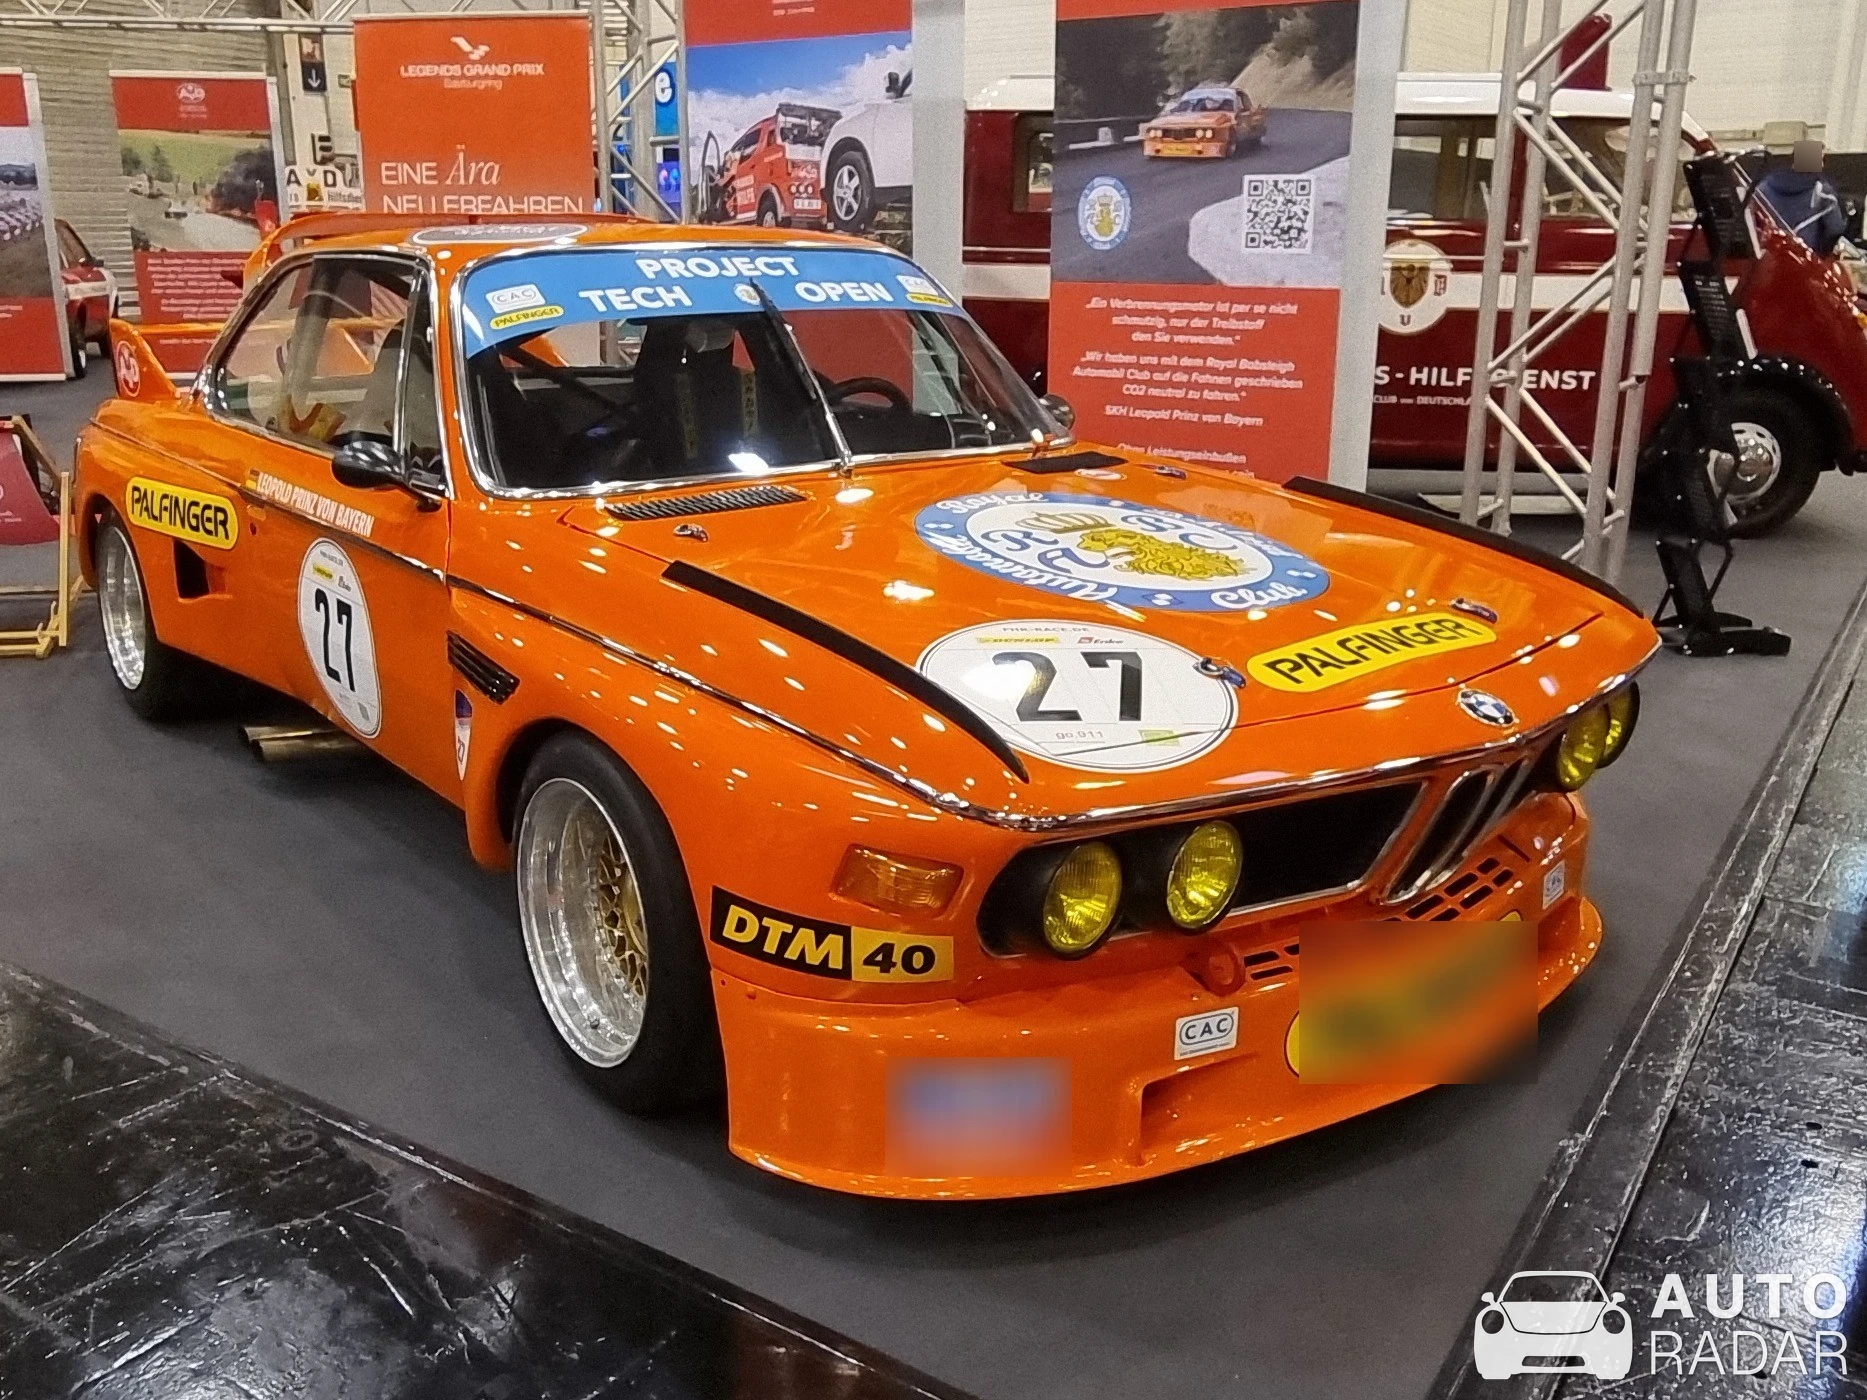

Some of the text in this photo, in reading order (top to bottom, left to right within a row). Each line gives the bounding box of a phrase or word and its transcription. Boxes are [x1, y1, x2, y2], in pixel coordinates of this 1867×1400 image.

[463, 63, 511, 76] GRAND
[512, 63, 544, 75] PRIX
[381, 144, 501, 185] EINE Ära
[383, 194, 436, 213] NEU
[443, 195, 583, 213] ERFAHREN
[635, 255, 799, 279] PROJECT
[578, 286, 691, 312] TECH
[795, 281, 894, 303] OPEN
[131, 486, 230, 541] PALFINGER
[257, 472, 374, 538] LEOPOLD PRINZ VON BAYERN
[315, 588, 355, 692] 27
[1262, 618, 1481, 684] PALFINGER
[992, 651, 1143, 722] 27
[722, 904, 937, 974] DTM 40
[1185, 1018, 1228, 1040] CAC
